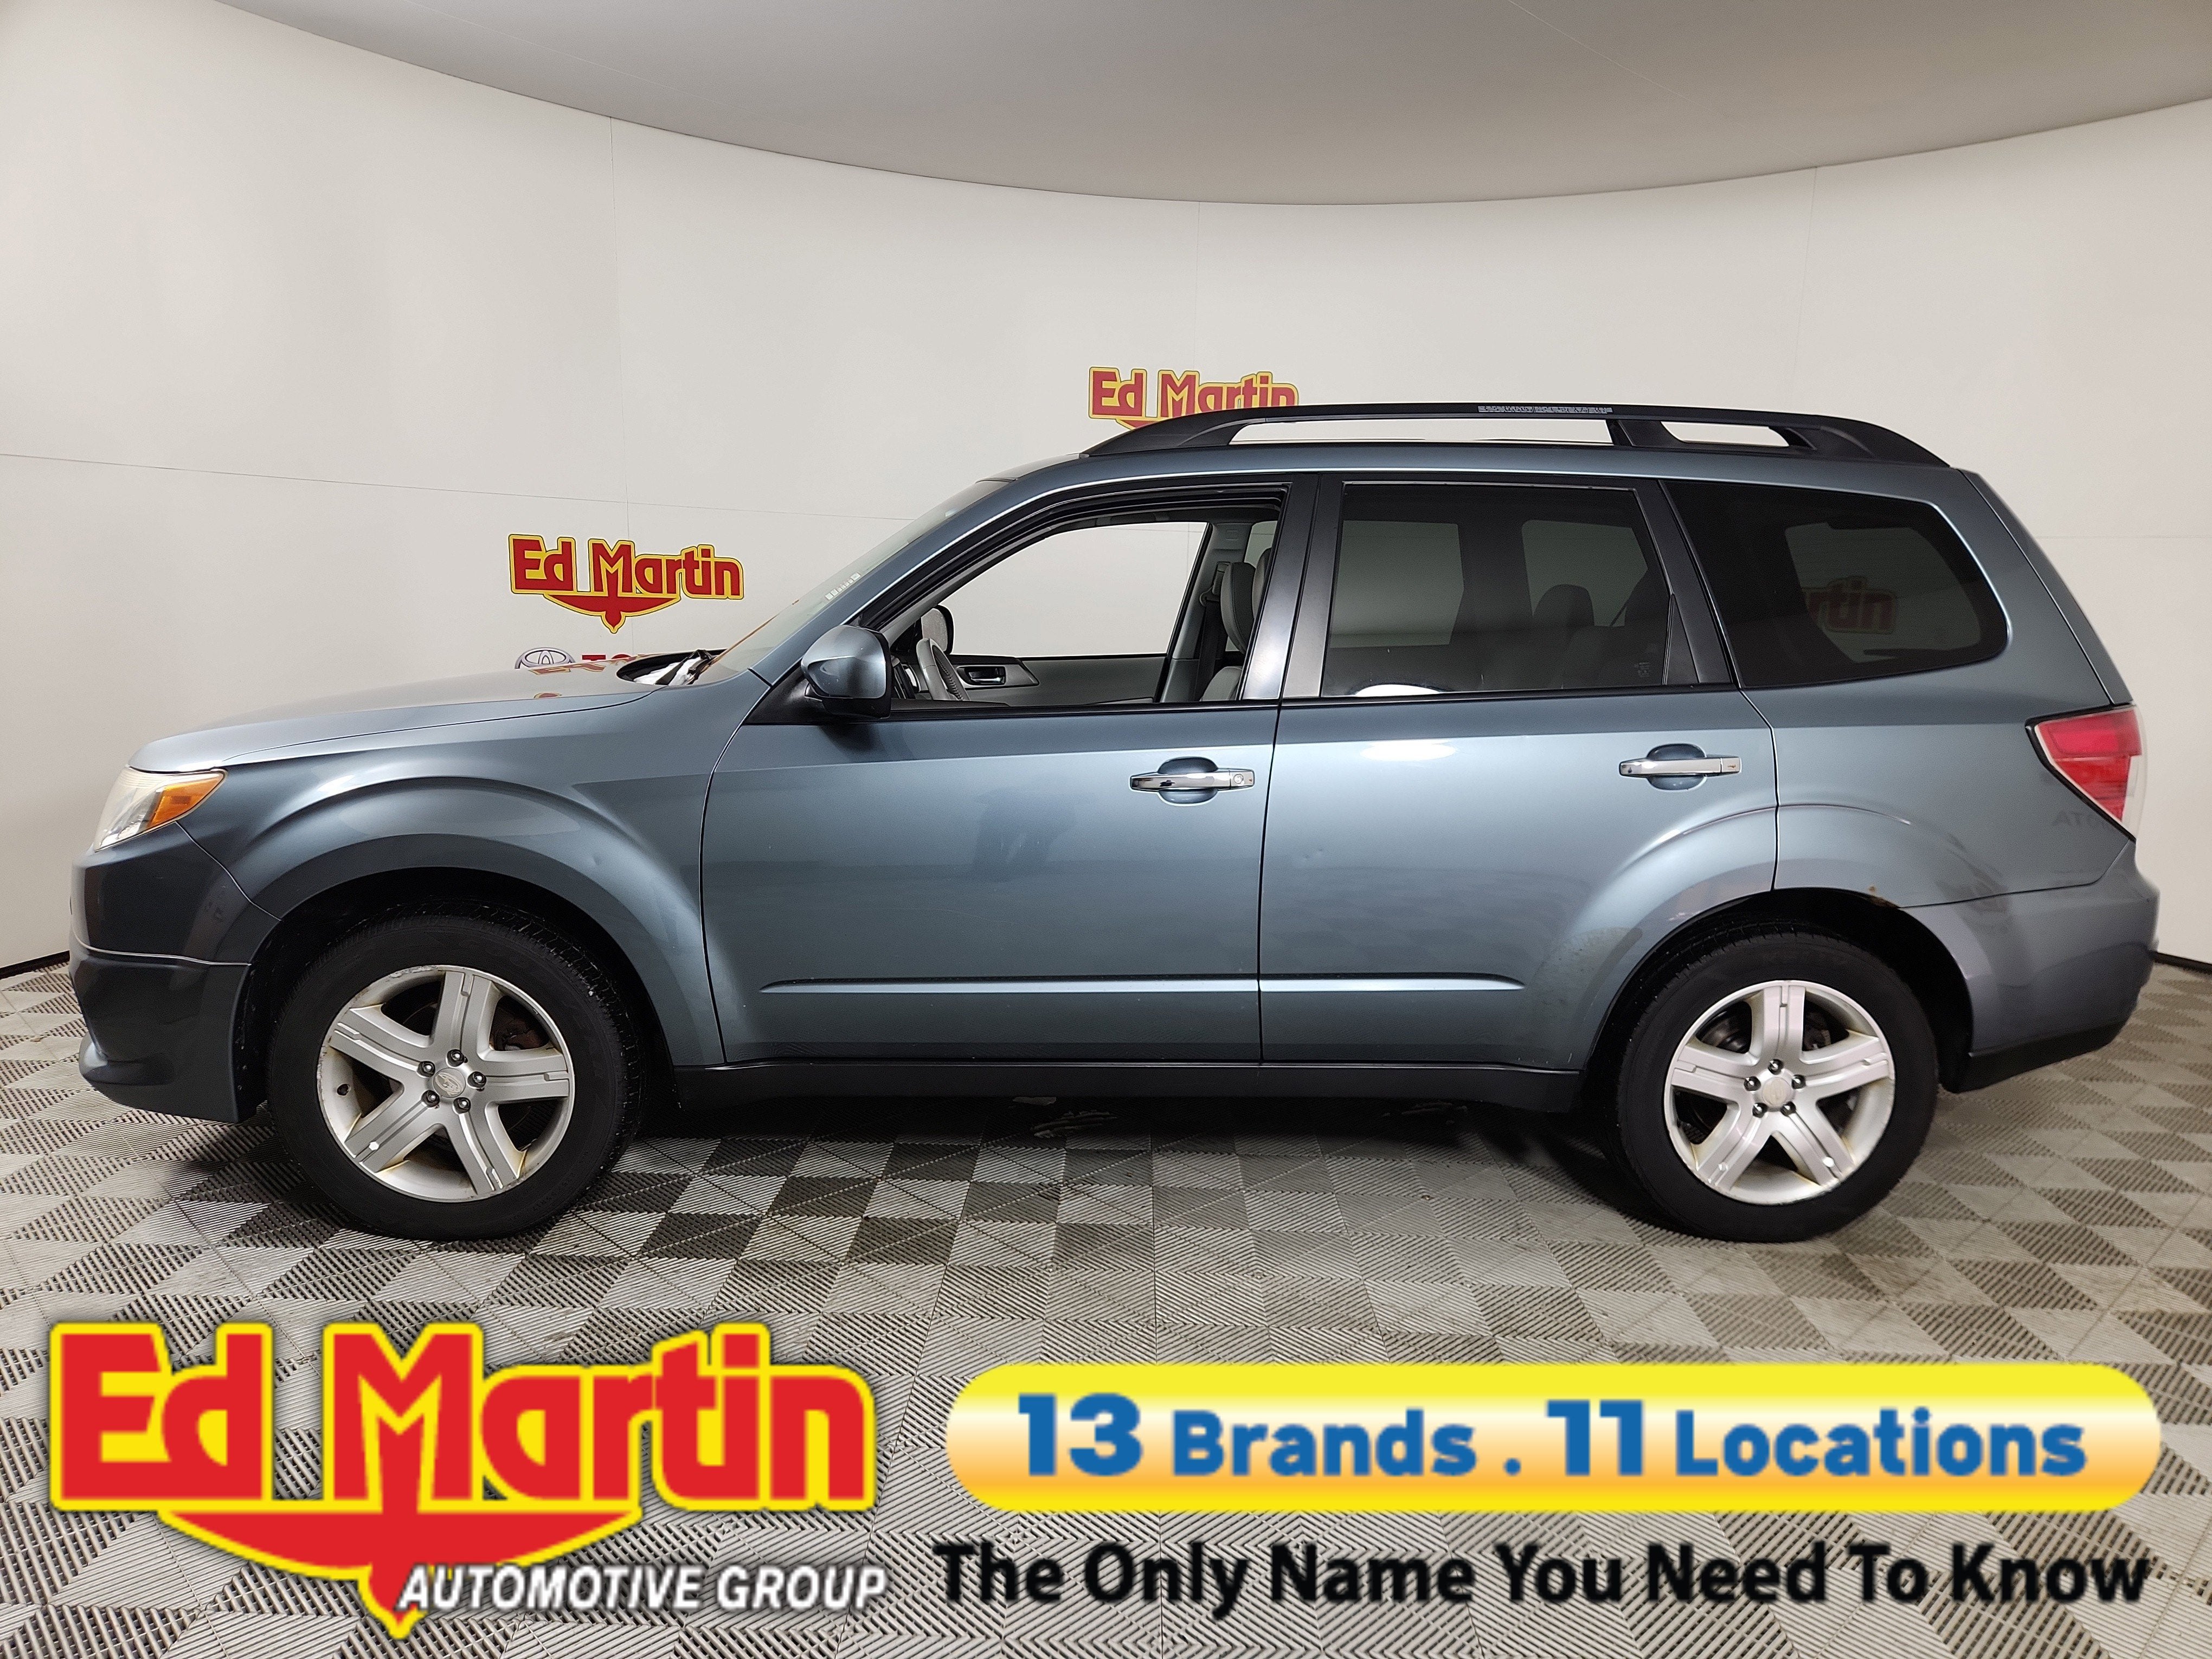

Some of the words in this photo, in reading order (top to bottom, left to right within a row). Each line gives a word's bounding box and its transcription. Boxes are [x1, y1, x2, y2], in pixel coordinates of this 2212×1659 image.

[1091, 369, 1144, 417] Ed
[512, 538, 574, 591] Ed
[591, 542, 741, 595] Martin
